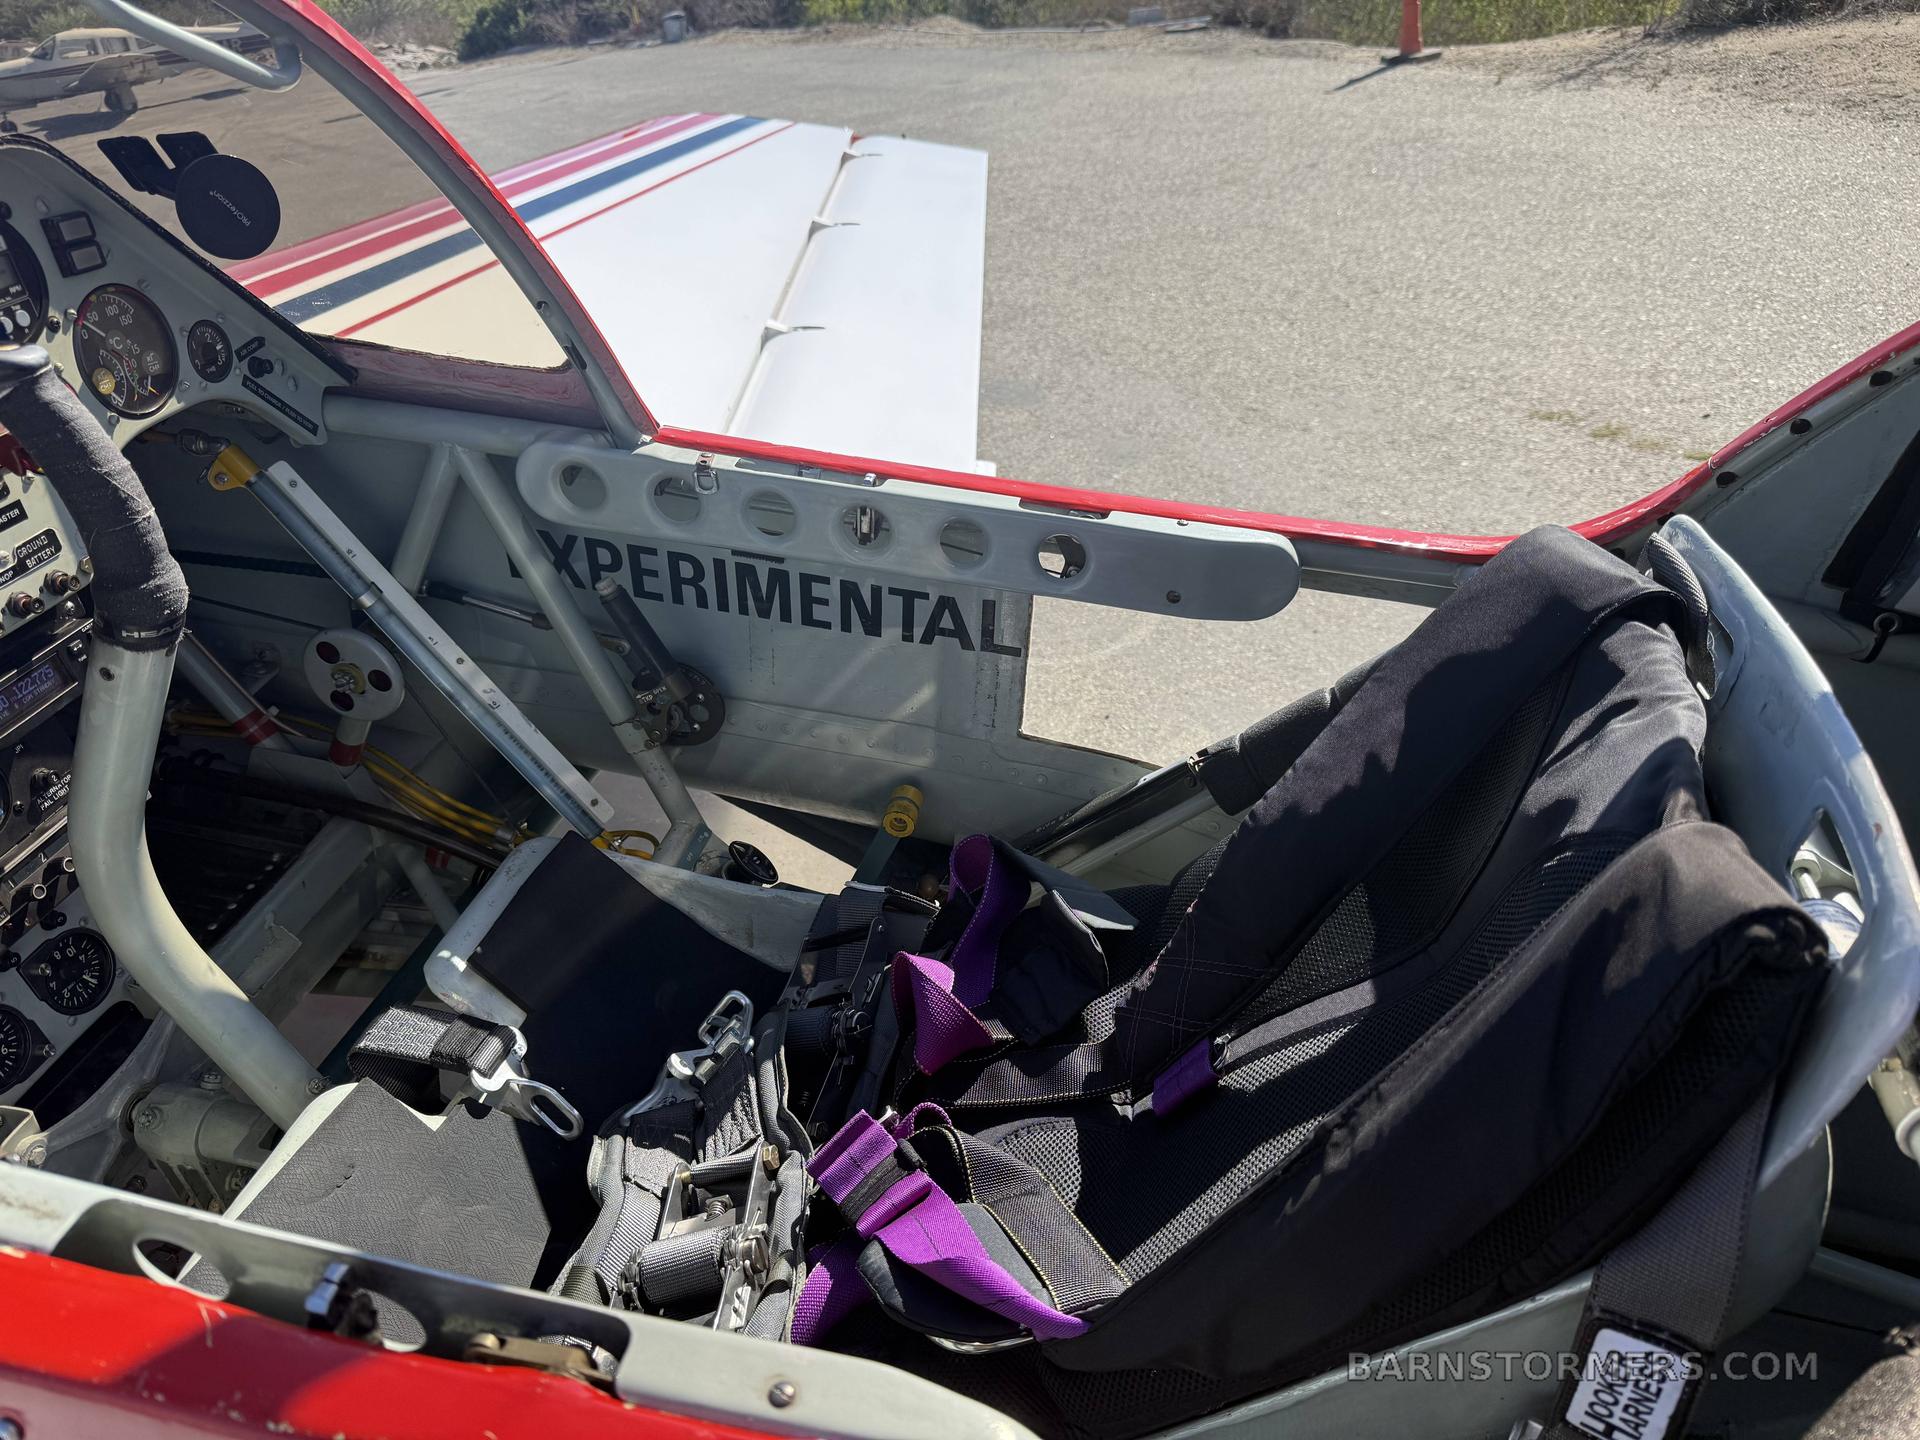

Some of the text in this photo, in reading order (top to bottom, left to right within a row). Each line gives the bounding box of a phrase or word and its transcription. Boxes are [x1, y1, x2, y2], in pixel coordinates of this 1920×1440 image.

[86, 311, 99, 323] 50
[105, 304, 118, 317] 100
[119, 314, 133, 326] 150
[0, 508, 20, 523] ASTER
[17, 535, 48, 558] GROUND
[26, 546, 56, 569] BATTERY
[0, 570, 14, 584] NOP
[53, 784, 70, 802] LIGHT
